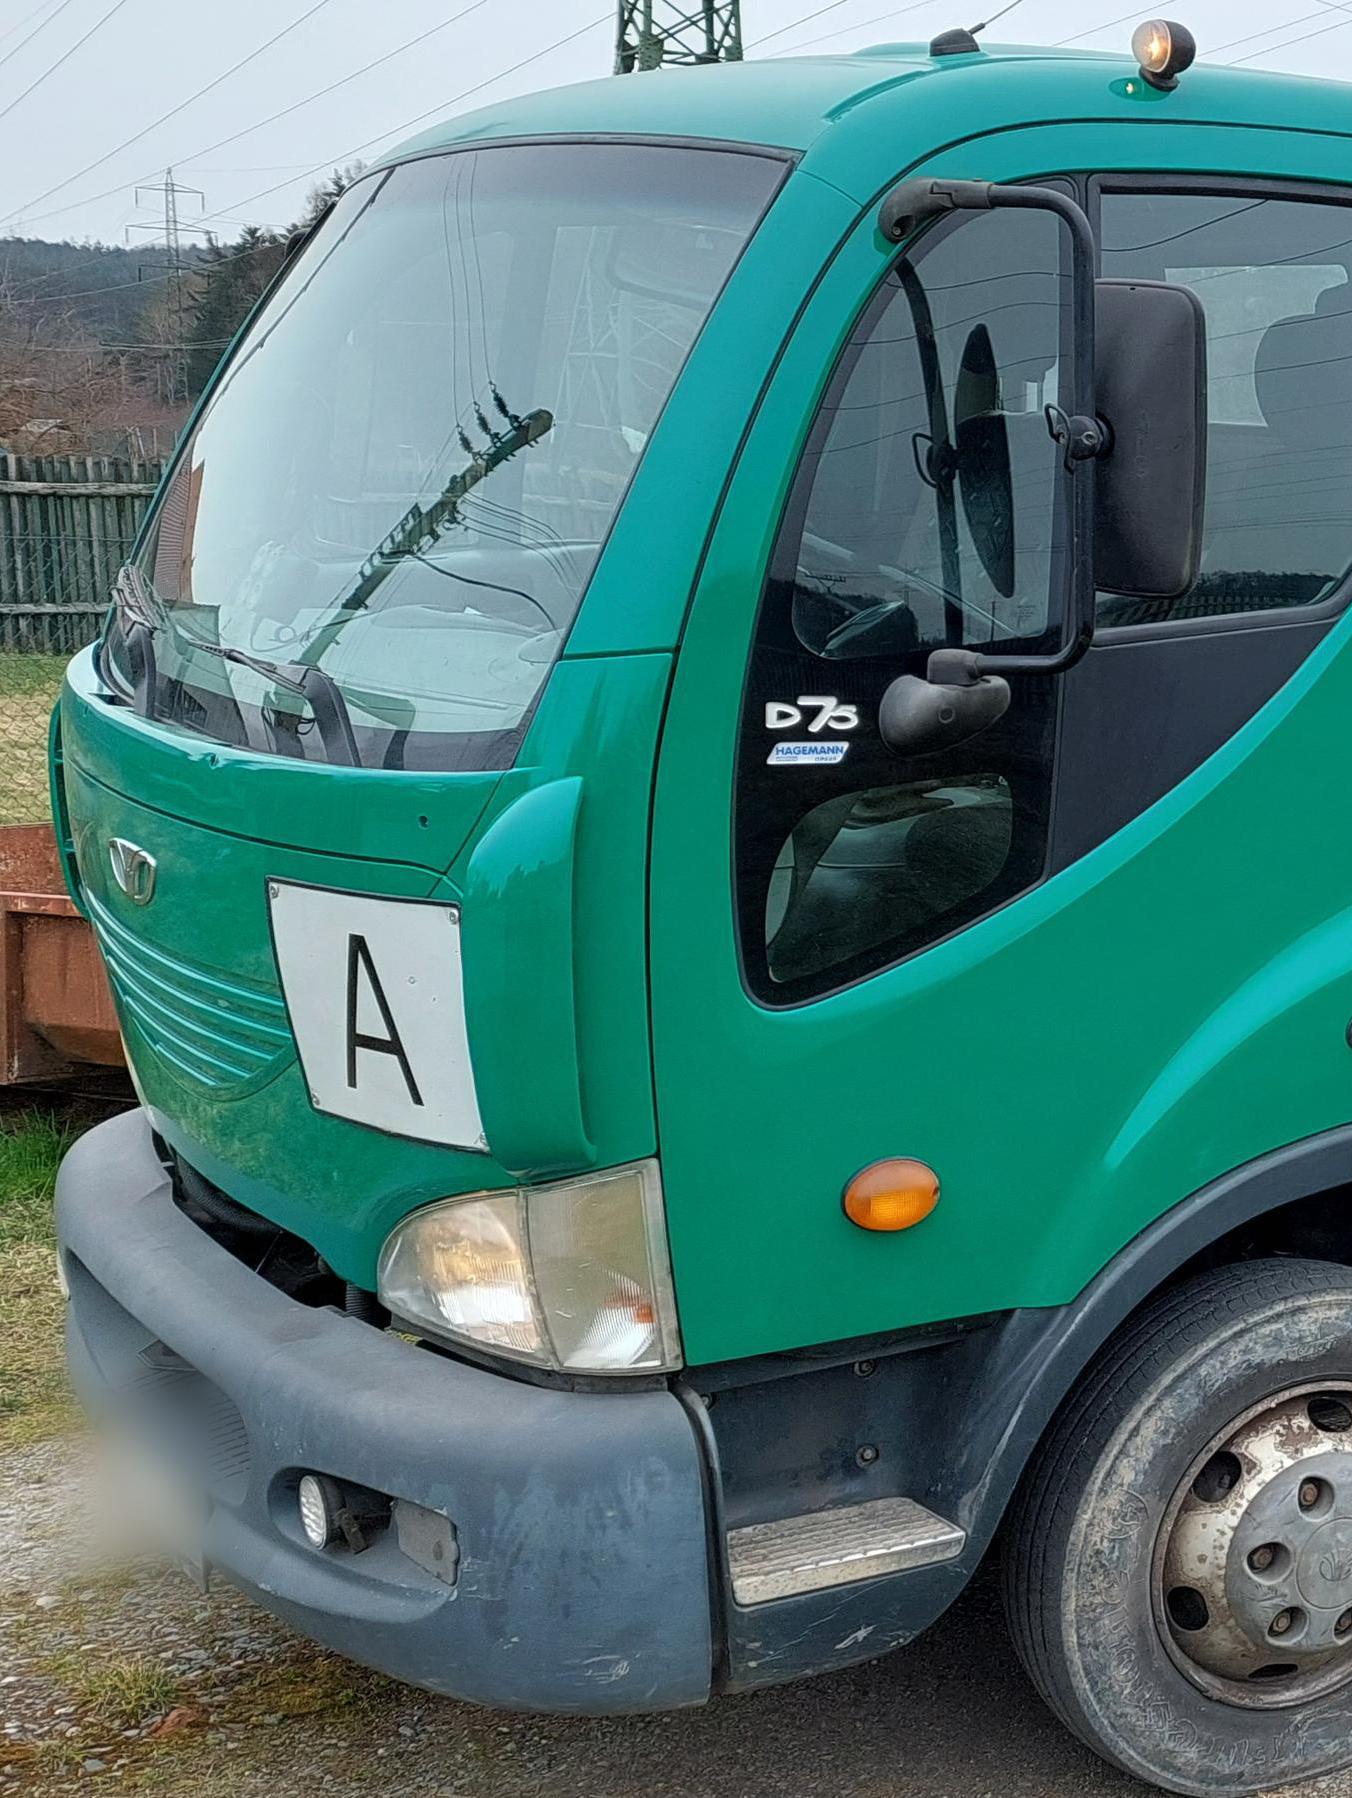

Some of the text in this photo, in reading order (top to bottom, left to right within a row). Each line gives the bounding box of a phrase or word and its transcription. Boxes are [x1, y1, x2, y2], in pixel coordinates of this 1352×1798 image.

[765, 696, 859, 733] D75
[775, 745, 844, 756] HAGEMANN
[346, 932, 425, 1107] A
